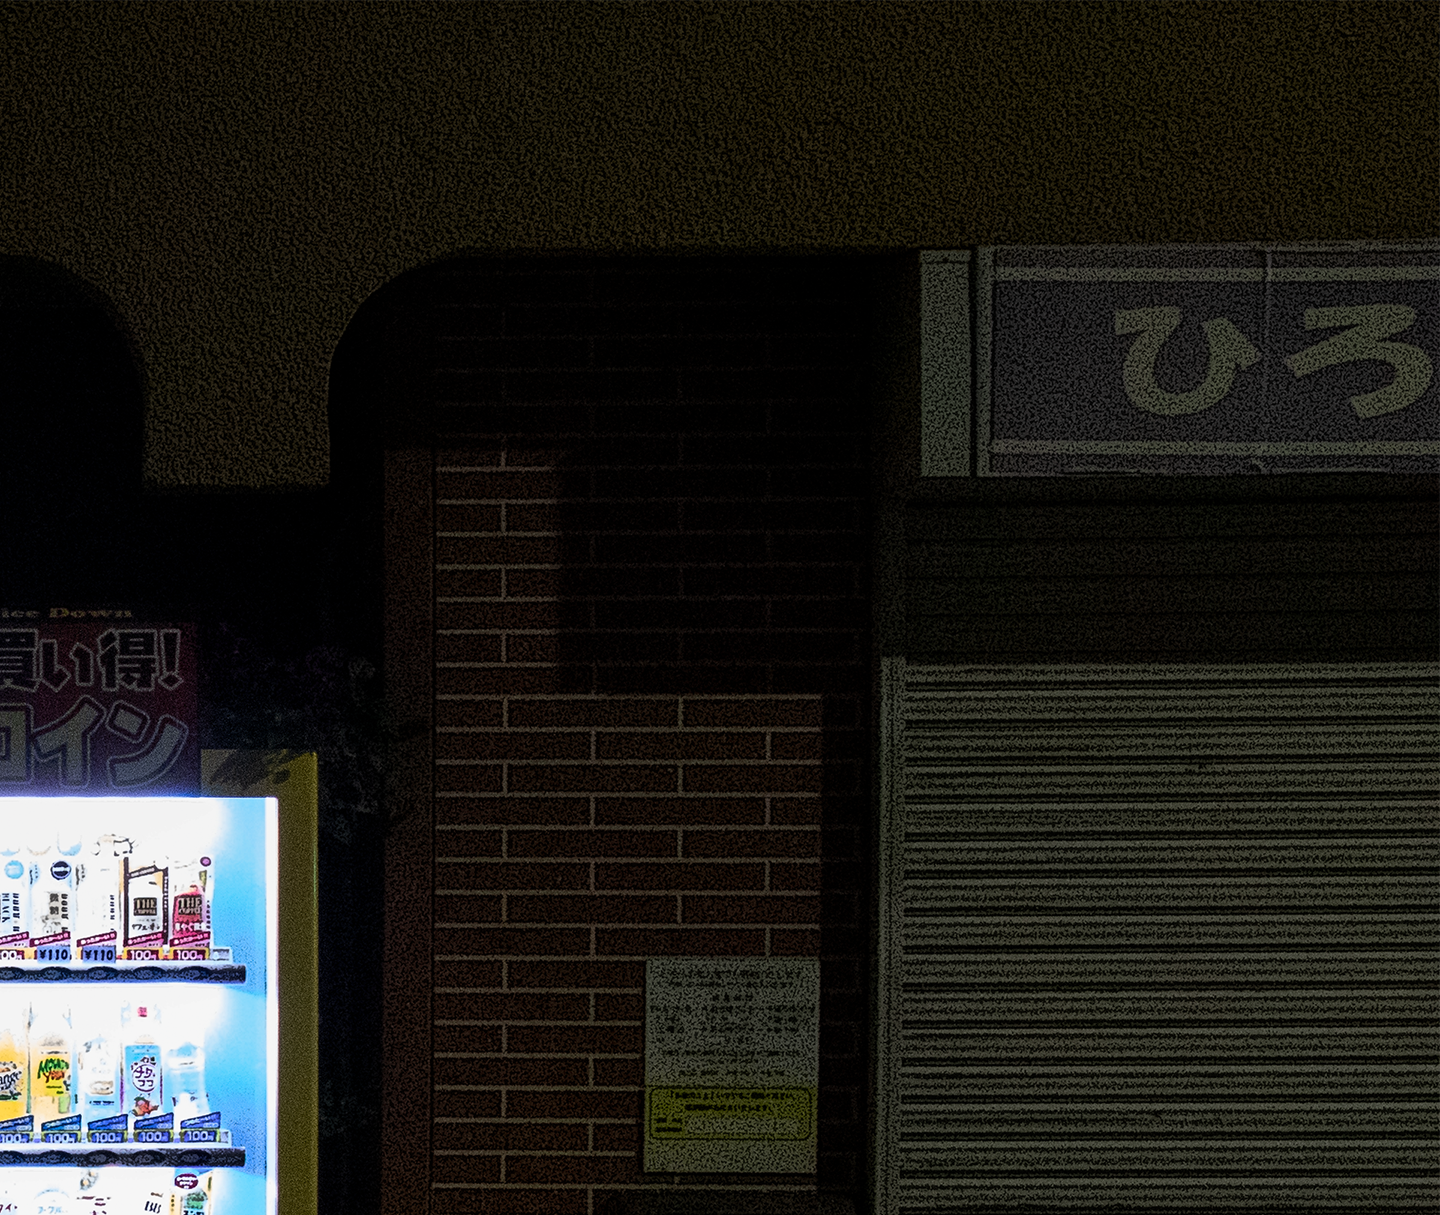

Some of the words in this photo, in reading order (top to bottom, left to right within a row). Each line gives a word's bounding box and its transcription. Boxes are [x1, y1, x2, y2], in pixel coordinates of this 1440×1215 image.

[1114, 304, 1433, 419] ひろ
[48, 607, 133, 620] Down
[39, 948, 69, 961] ¥110
[84, 948, 114, 961] ¥110
